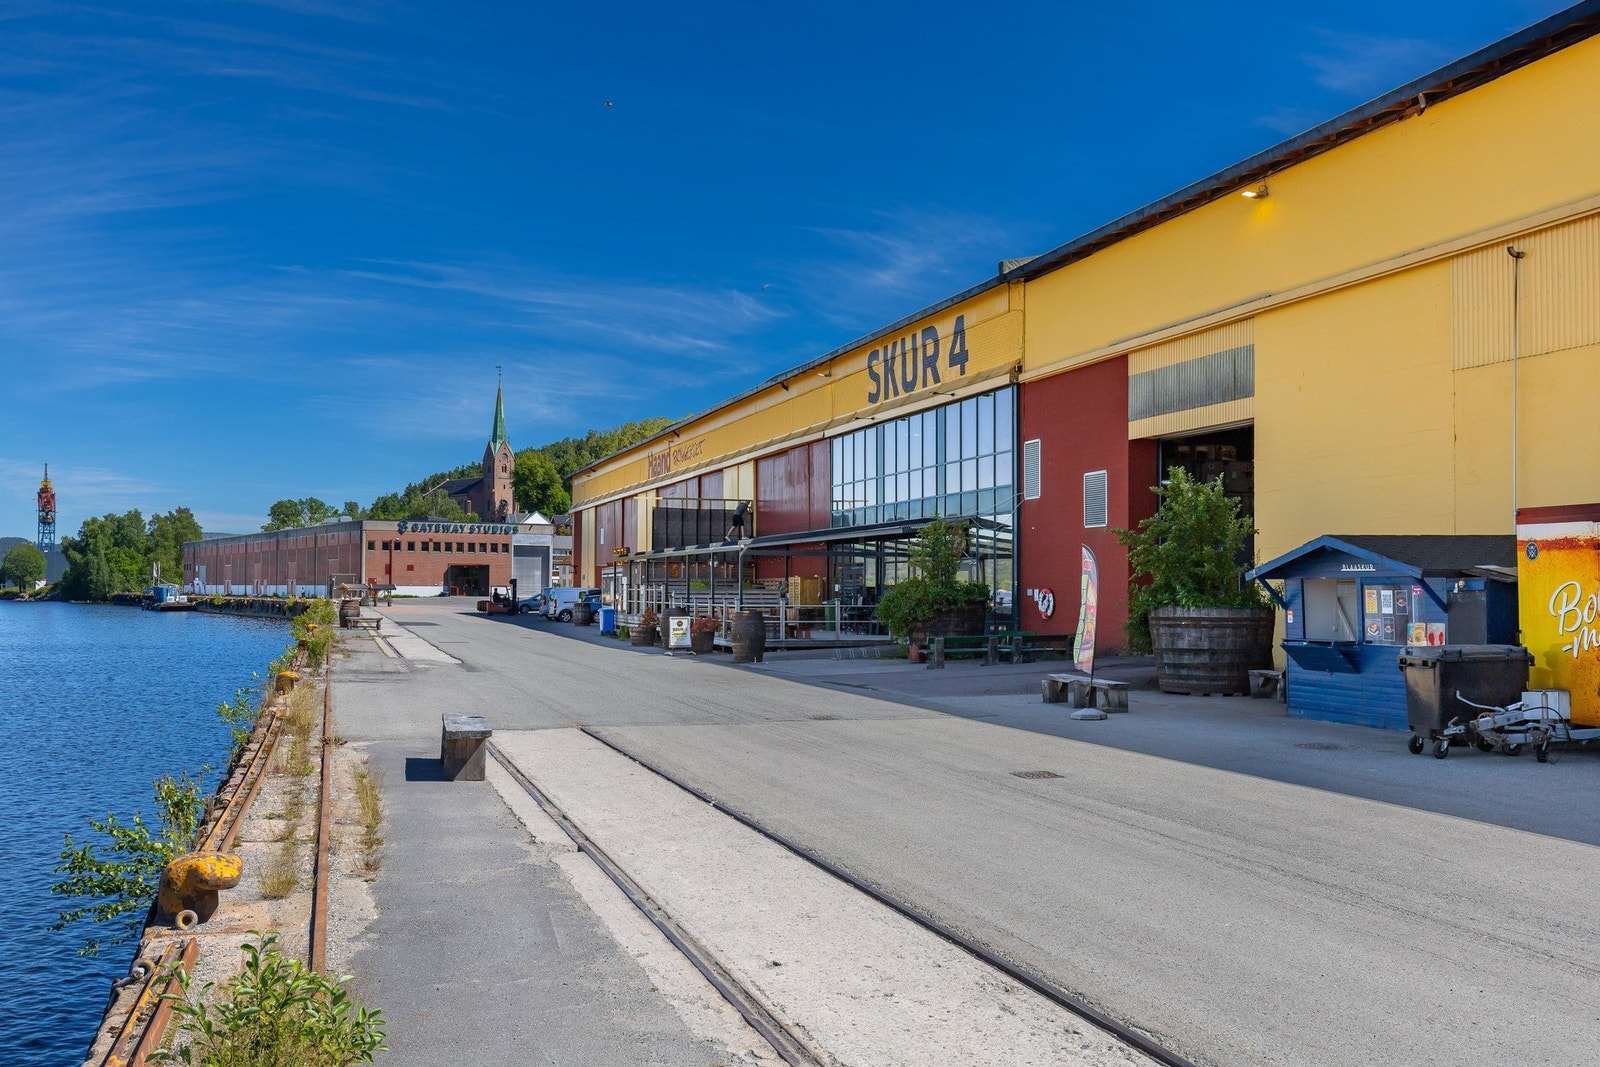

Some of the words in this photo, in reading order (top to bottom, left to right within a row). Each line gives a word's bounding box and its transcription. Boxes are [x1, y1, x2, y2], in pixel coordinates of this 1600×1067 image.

[867, 326, 941, 404] SKUR
[949, 315, 969, 376] 4
[648, 443, 671, 479] Haand
[411, 523, 466, 534] GATEWAY
[469, 524, 519, 535] STUDIOS
[1549, 580, 1600, 636] Bo
